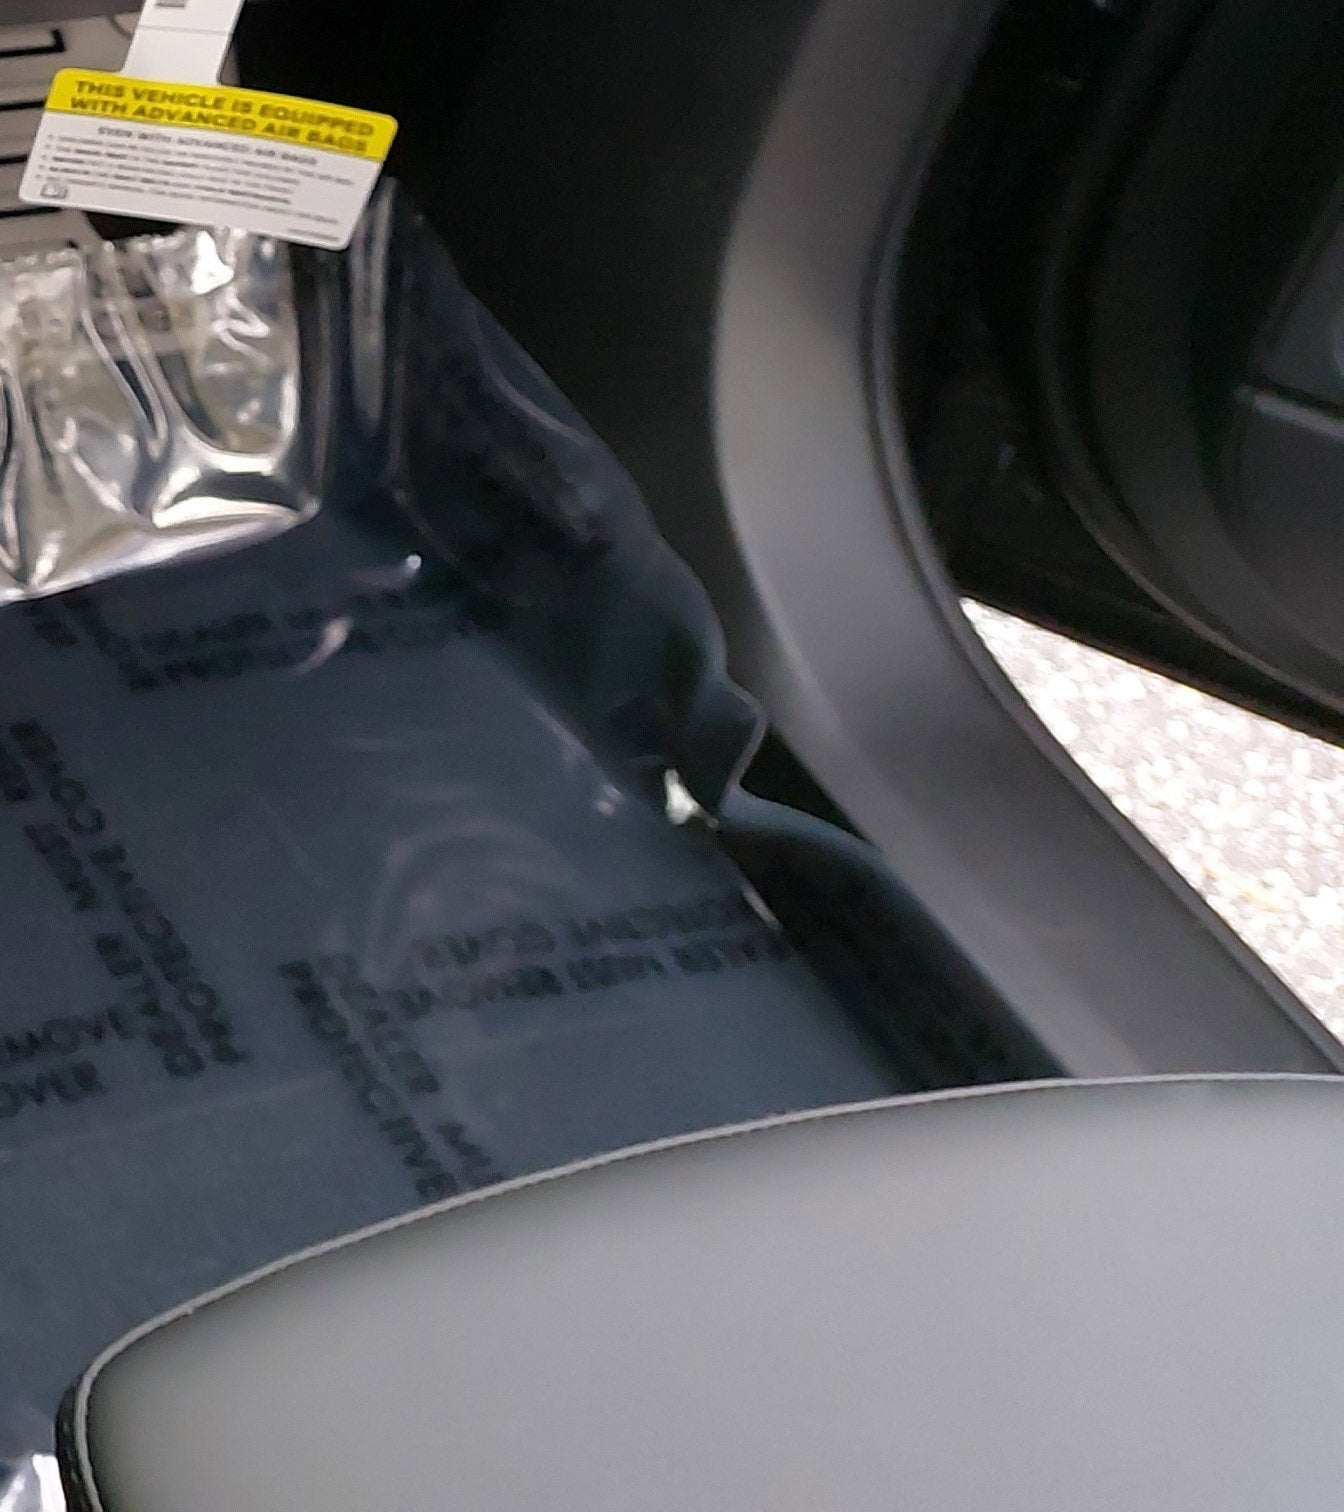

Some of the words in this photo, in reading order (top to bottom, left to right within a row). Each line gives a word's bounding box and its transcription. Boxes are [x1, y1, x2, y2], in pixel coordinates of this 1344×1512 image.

[70, 96, 128, 116] WITH
[136, 103, 258, 133] ADVANCED
[265, 122, 301, 141] AIR
[307, 129, 369, 153] BAGS
[76, 79, 126, 99] THIS
[132, 86, 226, 112] VEHICLE
[230, 99, 253, 114] IS
[258, 102, 375, 138] EQUIPPED
